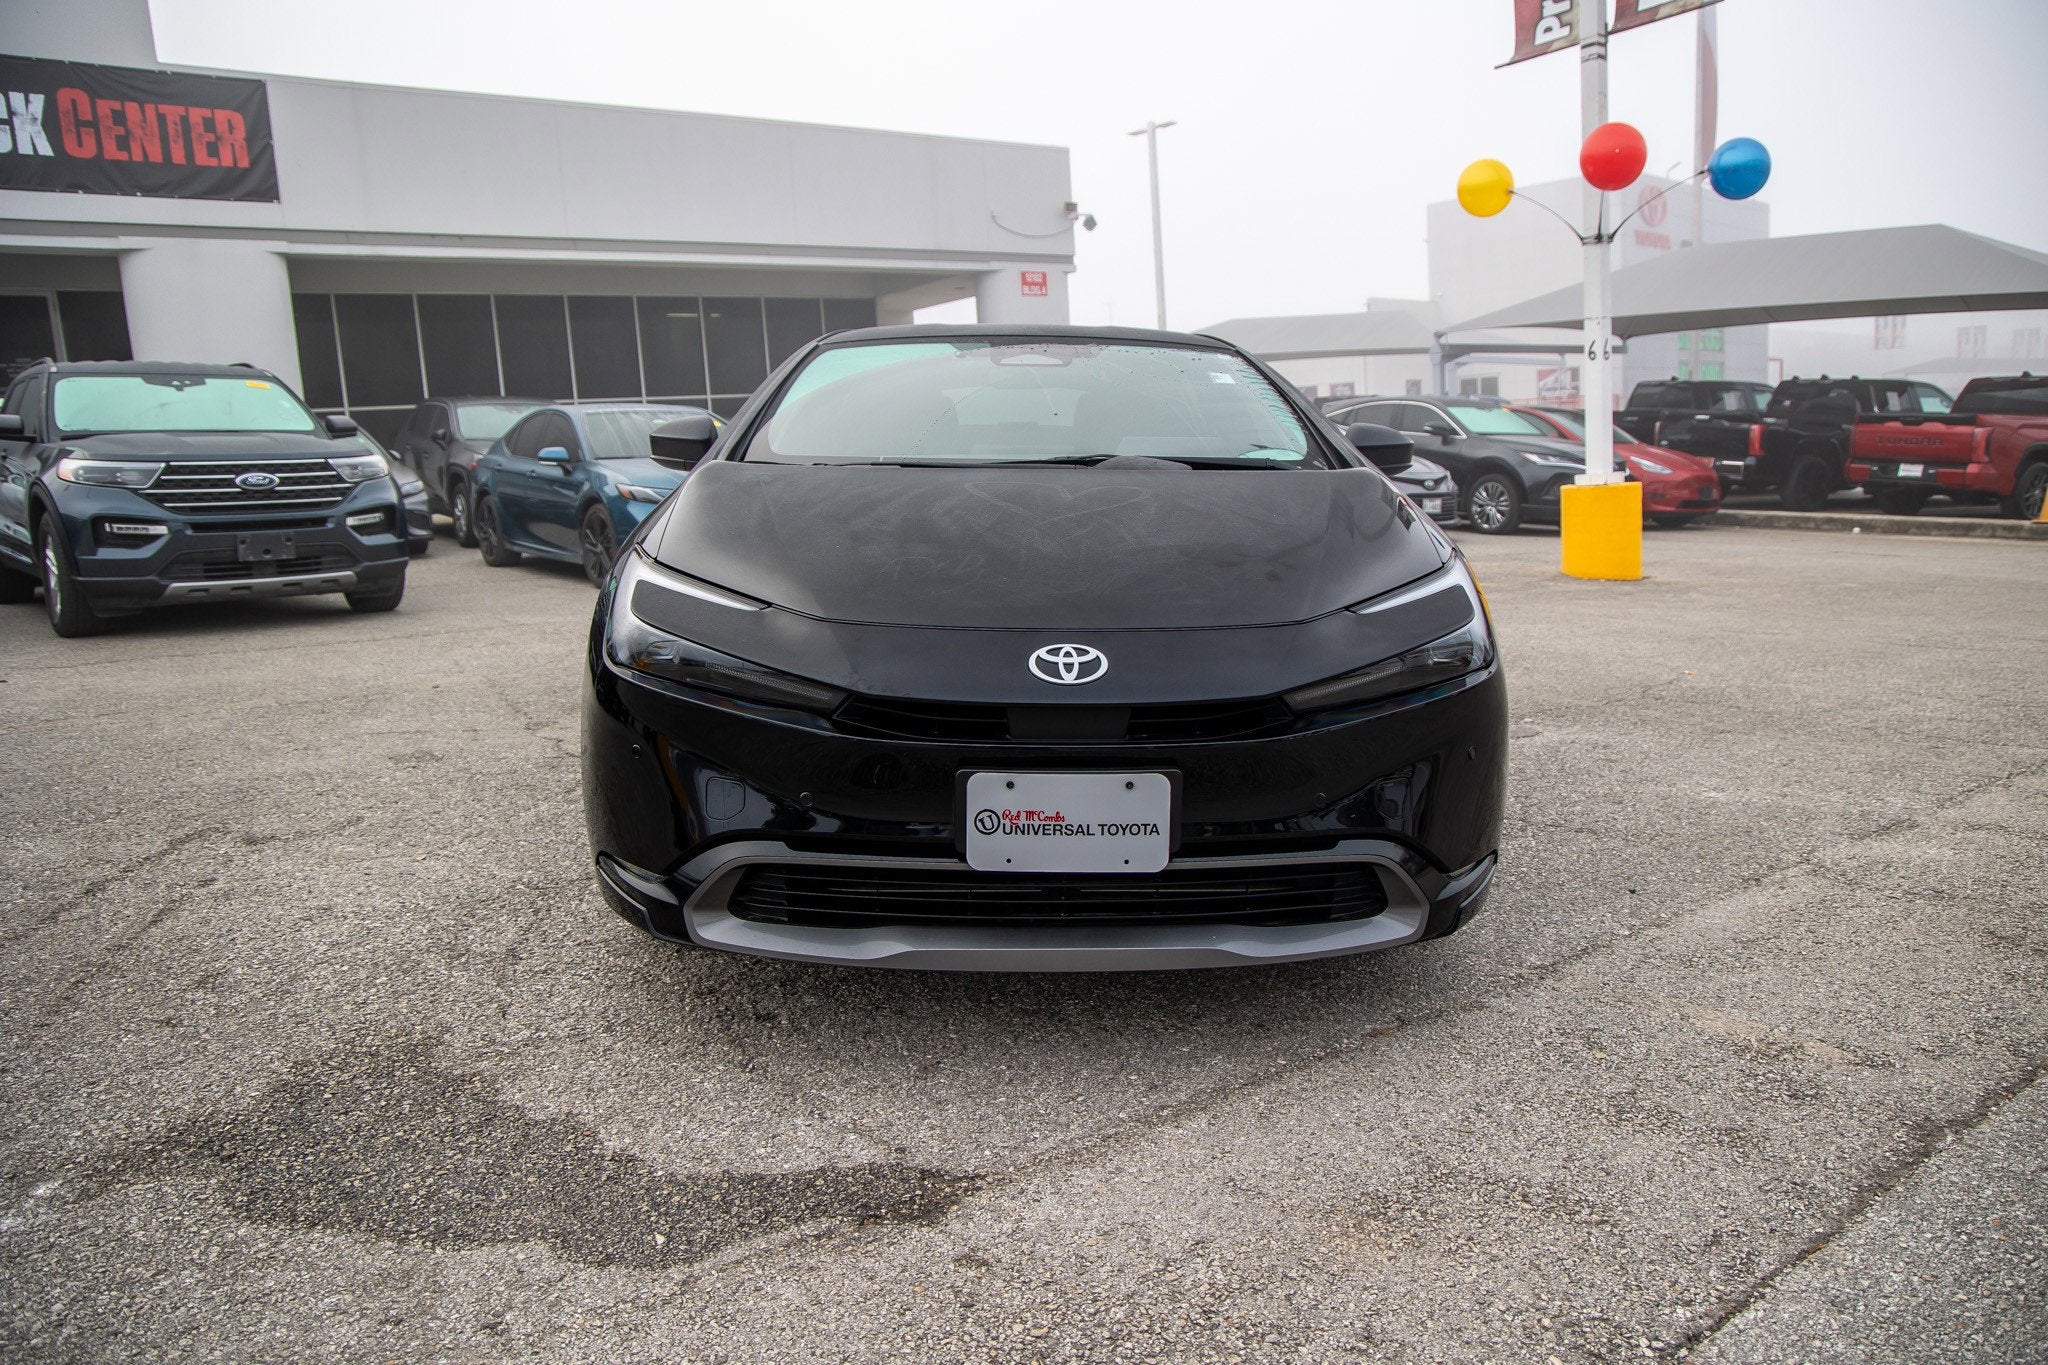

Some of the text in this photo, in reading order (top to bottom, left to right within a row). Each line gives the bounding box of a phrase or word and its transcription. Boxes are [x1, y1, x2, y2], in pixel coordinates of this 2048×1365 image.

[56, 87, 250, 168] CENTER
[1002, 809, 1065, 825] Red McCombs
[1002, 823, 1160, 836] UNIVERSAL TOYOTA
